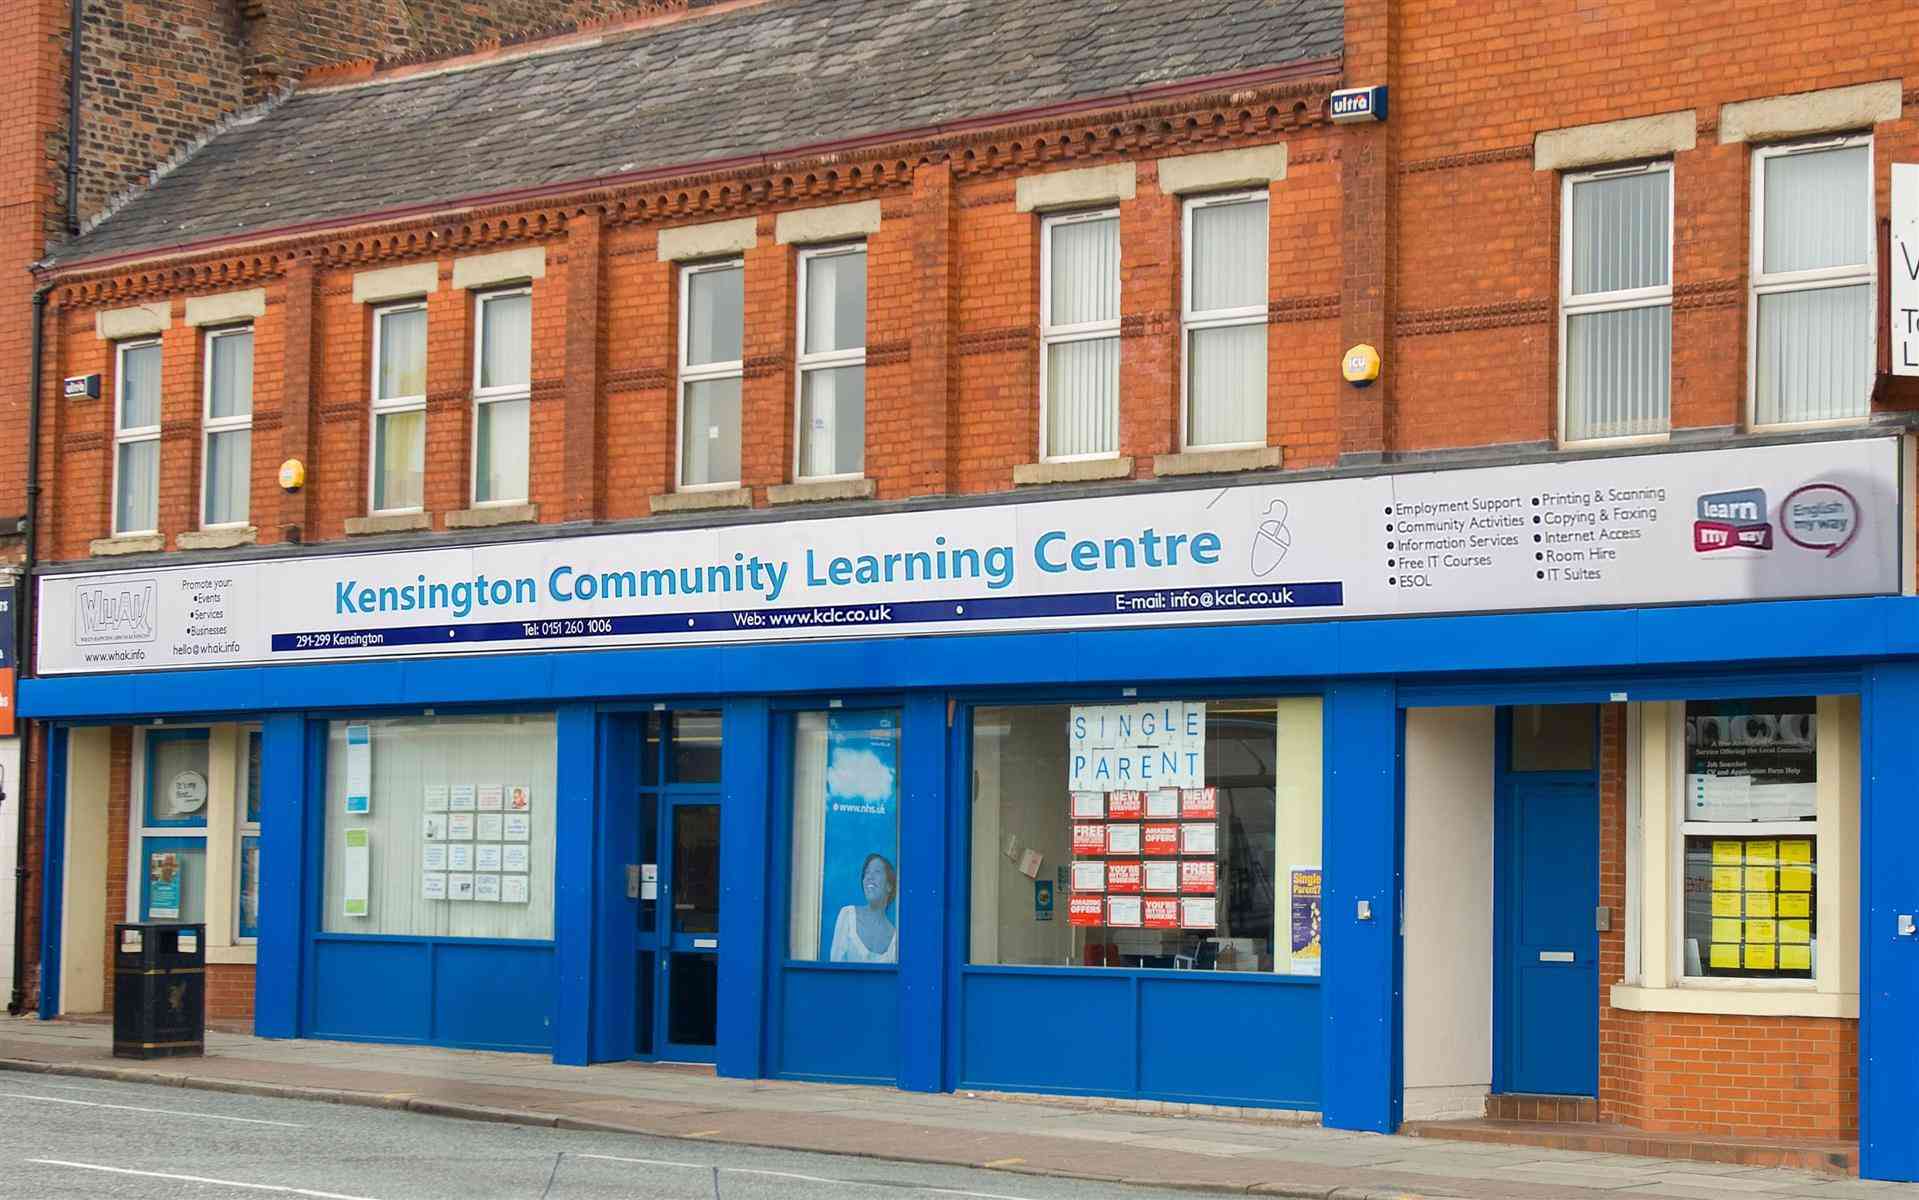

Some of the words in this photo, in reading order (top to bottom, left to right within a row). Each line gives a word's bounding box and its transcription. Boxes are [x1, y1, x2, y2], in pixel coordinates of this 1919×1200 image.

[1334, 96, 1368, 112] ultra
[1542, 492, 1591, 508] Printing
[1595, 491, 1604, 503] &
[1608, 486, 1666, 502] Scanning
[1396, 500, 1469, 517] Employment
[1473, 497, 1522, 512] Support
[1703, 501, 1758, 520] learn
[1793, 501, 1844, 518] English
[1544, 510, 1596, 526] Copying
[1599, 509, 1609, 521] &
[1613, 507, 1657, 522] Faxing
[1397, 518, 1465, 534] Community
[1469, 515, 1525, 530] Activities
[1794, 518, 1816, 531] my
[1818, 517, 1848, 532] way
[1398, 537, 1466, 551] Information
[1469, 534, 1519, 548] Services
[1545, 530, 1595, 544] Internet
[1599, 528, 1642, 541] Access
[1701, 529, 1729, 546] my
[1738, 529, 1766, 544] way
[1399, 557, 1424, 570] Free
[1428, 556, 1439, 568] IT
[1443, 555, 1492, 568] Courses
[1546, 549, 1585, 562] Room
[1589, 548, 1616, 560] Hire
[335, 575, 536, 618] Kensington
[549, 553, 788, 601] Community
[806, 536, 1014, 589] Learning
[1034, 528, 1221, 573] Centre
[1547, 568, 1559, 581] IT
[1564, 567, 1601, 580] Suites
[182, 579, 212, 590] Promote
[1400, 575, 1432, 588] ESOL
[198, 593, 221, 604] Events
[1116, 592, 1166, 610] E-mail:
[1170, 587, 1294, 609] info@kclc.co.uk
[195, 609, 224, 620] Services
[733, 612, 766, 627] Web:
[769, 605, 892, 625] www.kclc.co.uk
[191, 625, 228, 636] Businesses
[523, 623, 539, 636] Tel:
[542, 622, 562, 635] 0151
[564, 621, 584, 635] 260
[587, 619, 613, 634] 1006
[296, 634, 331, 648] 291-299
[333, 632, 383, 648] Kensington
[85, 649, 145, 662] www.whak.info
[173, 641, 240, 656] hello@whak.info
[1074, 708, 1199, 740] SINGLE
[1074, 751, 1199, 780] PARENT
[1110, 791, 1140, 801] NEW
[1183, 789, 1214, 801] NEW
[1074, 825, 1104, 837] FREE
[1145, 834, 1176, 842] OFFERS
[1183, 862, 1214, 874] FREE
[1070, 905, 1101, 914] OFFERS
